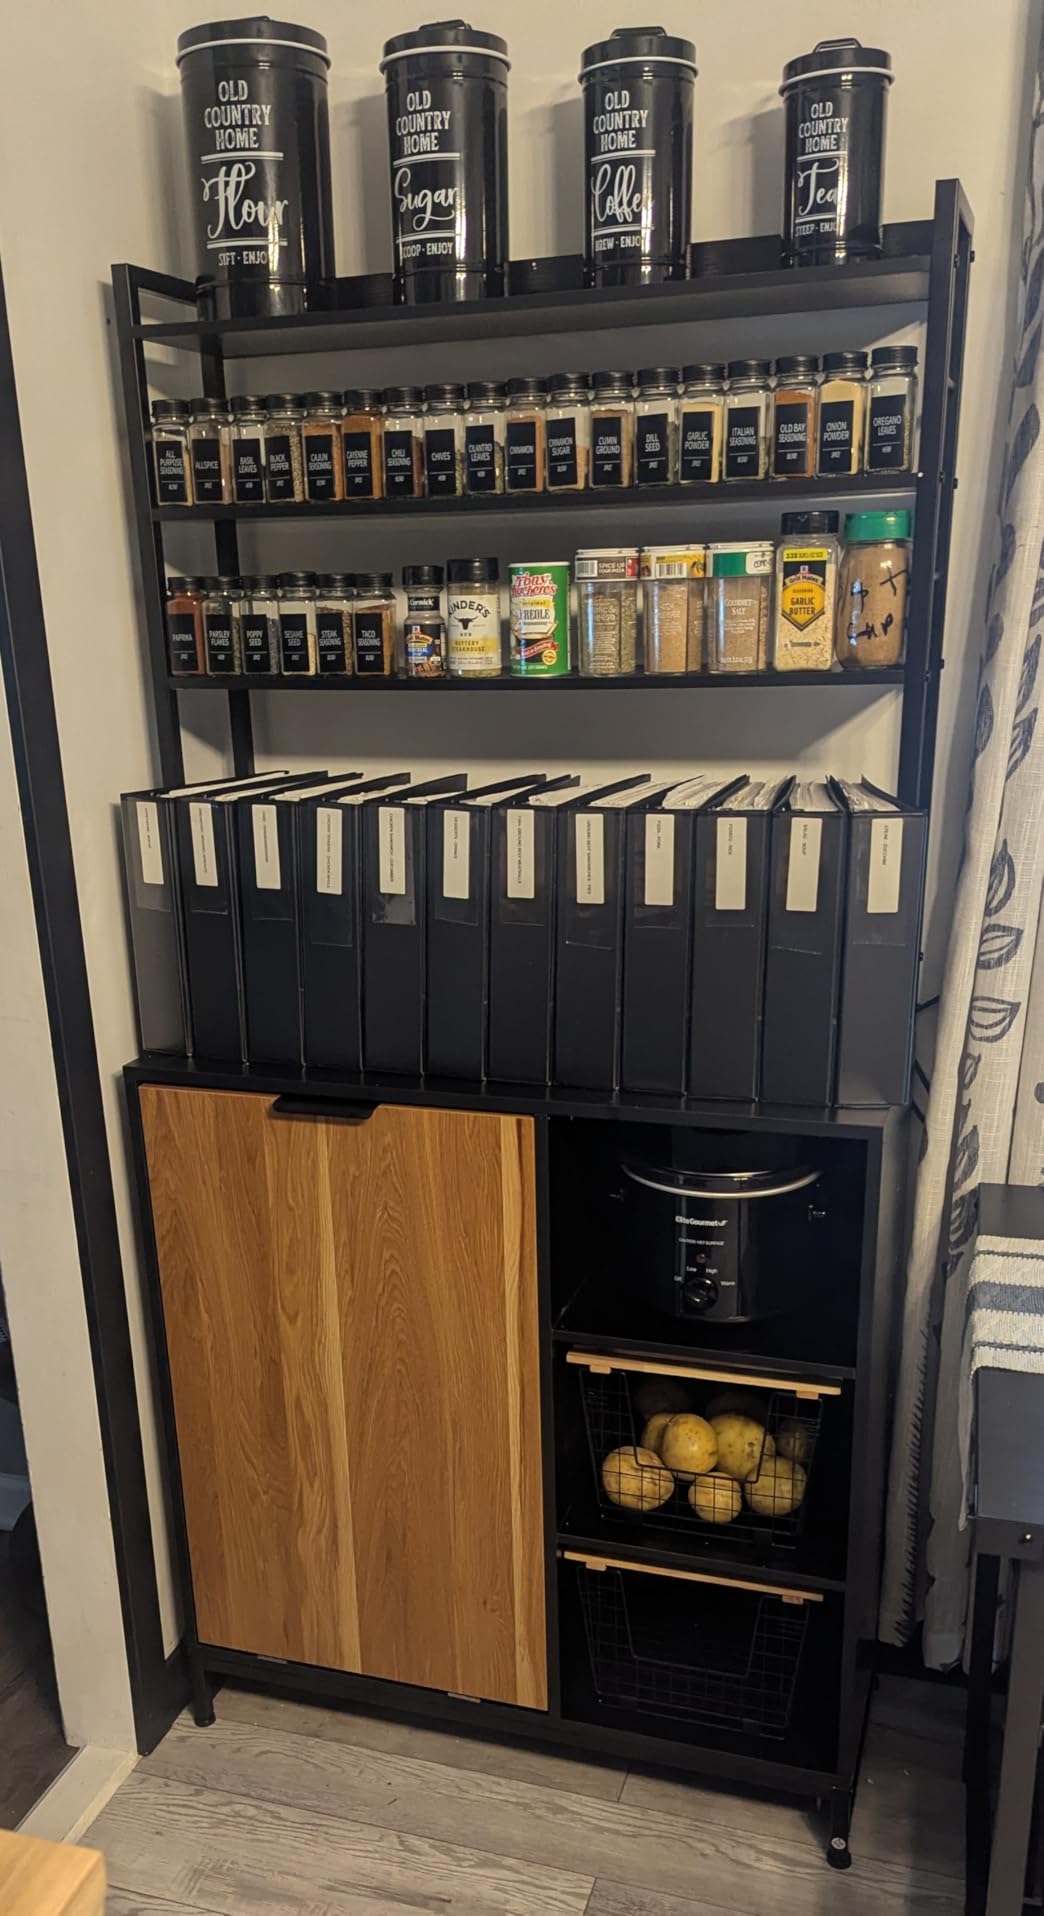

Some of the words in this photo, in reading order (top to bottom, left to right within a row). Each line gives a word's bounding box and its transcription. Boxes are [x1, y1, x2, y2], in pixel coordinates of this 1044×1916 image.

[218, 80, 248, 102] OLD
[406, 90, 432, 111] OLD
[604, 90, 630, 110] OLD
[810, 102, 833, 119] OLD
[204, 104, 272, 128] COUNTRY
[396, 110, 452, 136] COUNTRY
[593, 110, 648, 134] COUNTRY
[798, 118, 848, 138] COUNTRY
[215, 128, 260, 150] HOME
[404, 132, 440, 155] HOME
[600, 130, 636, 152] HOME
[805, 135, 838, 154] HOME
[590, 164, 647, 223] Coffe
[620, 235, 644, 248] ENJO
[426, 242, 454, 256] ENJOY
[218, 252, 235, 266] SIFT
[243, 250, 272, 265] ENJO
[873, 415, 902, 427] OREGANO
[731, 426, 755, 436] ITALIAN
[780, 424, 792, 434] OLD
[794, 423, 806, 432] BAY
[826, 421, 848, 432] ONION
[878, 426, 897, 436] LEAVES
[598, 436, 618, 446] CUMIN
[646, 434, 660, 442] DILL
[686, 432, 708, 440] GARLIC
[729, 436, 756, 446] SEASONING
[778, 432, 806, 443] SEASONING
[824, 430, 850, 442] POWDER
[596, 445, 620, 454] GROUND
[644, 442, 660, 452] SEED
[684, 440, 710, 450] POWDER
[391, 449, 406, 458] CHILI
[552, 446, 571, 456] SUGAR
[240, 456, 255, 465] BASIL
[270, 454, 286, 463] BLACK
[310, 453, 328, 462] CAJUN
[431, 452, 452, 461] CHIVES
[470, 452, 490, 462] LEAVES
[195, 460, 218, 470] ALLSPICE
[238, 465, 258, 474] LEAVES
[270, 462, 290, 472] PEPPER
[790, 596, 816, 606] GARLIC
[789, 606, 816, 616] BUTTER
[172, 633, 193, 642] PAPRIKA
[208, 630, 230, 638] PARSLEY
[246, 630, 263, 638] POPPY
[321, 630, 338, 638] STEAK
[361, 630, 376, 638] TACO
[210, 638, 230, 646] FLAKES
[248, 638, 262, 646] SEED
[288, 638, 301, 646] SEED
